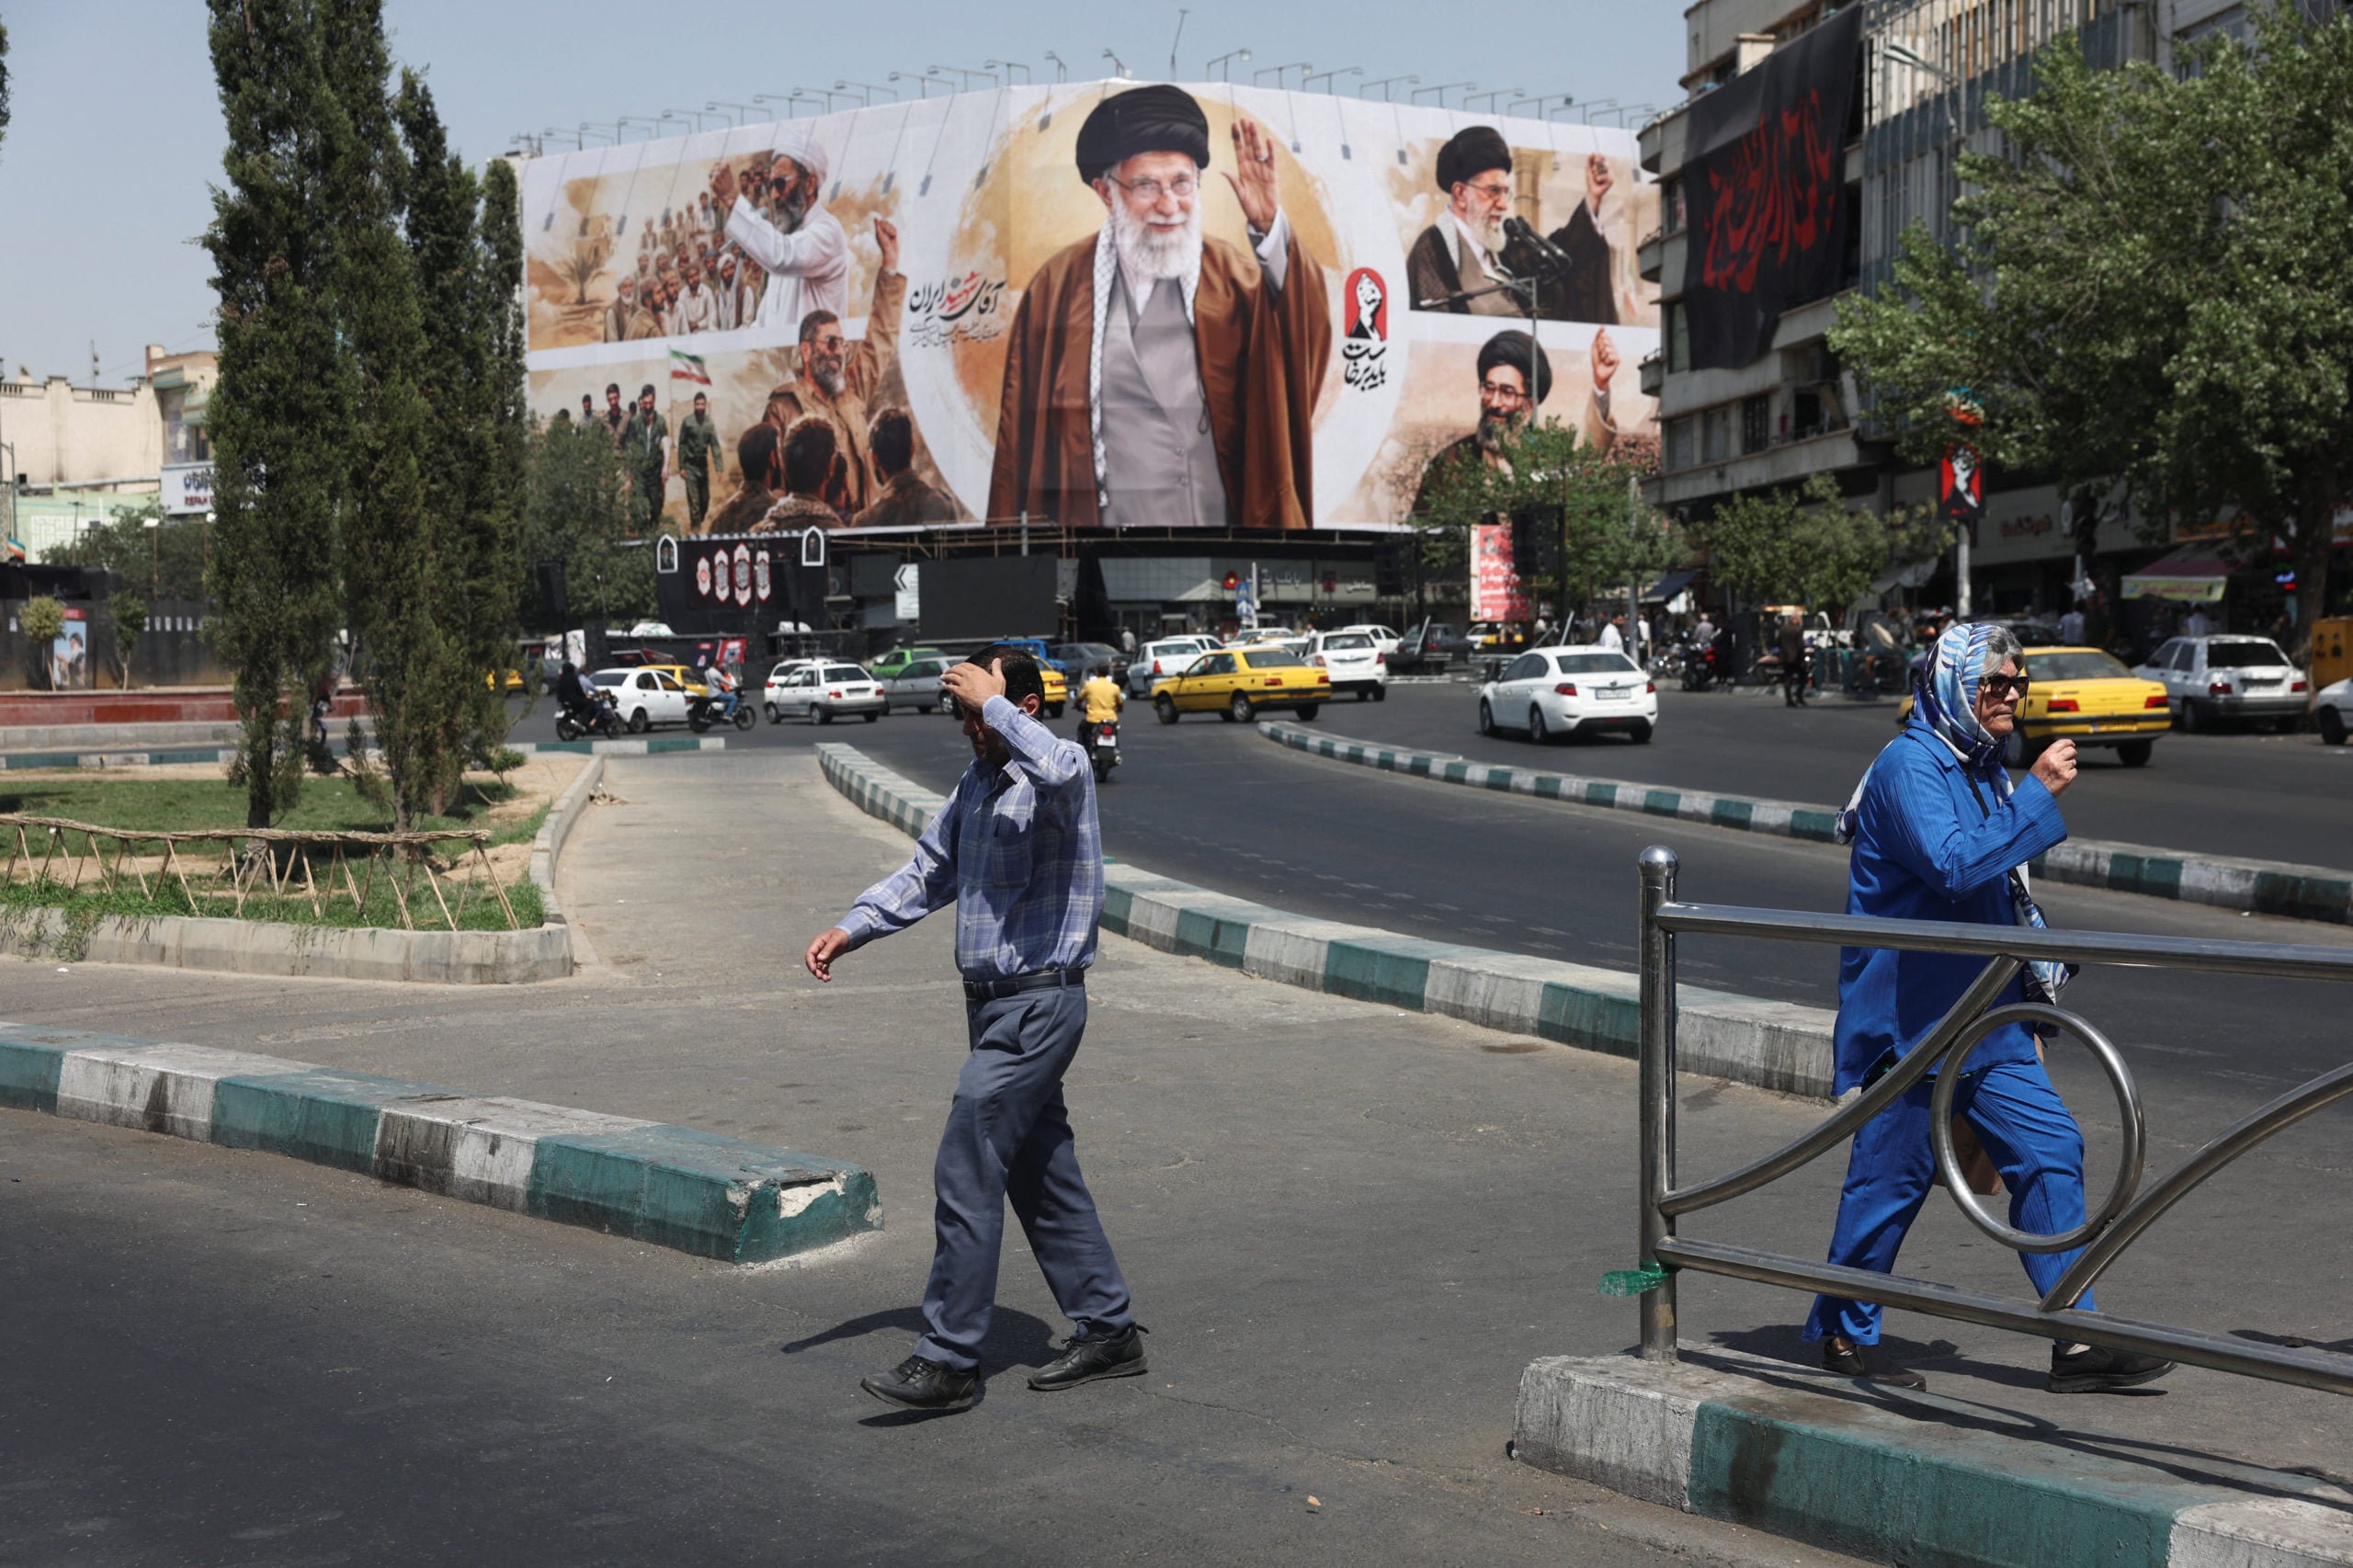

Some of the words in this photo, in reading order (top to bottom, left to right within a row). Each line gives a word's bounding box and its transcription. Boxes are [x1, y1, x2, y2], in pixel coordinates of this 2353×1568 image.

[909, 279, 946, 313] ایران
[938, 271, 981, 312] شهید
[938, 278, 1006, 321] آقای
[1364, 359, 1386, 391] باید
